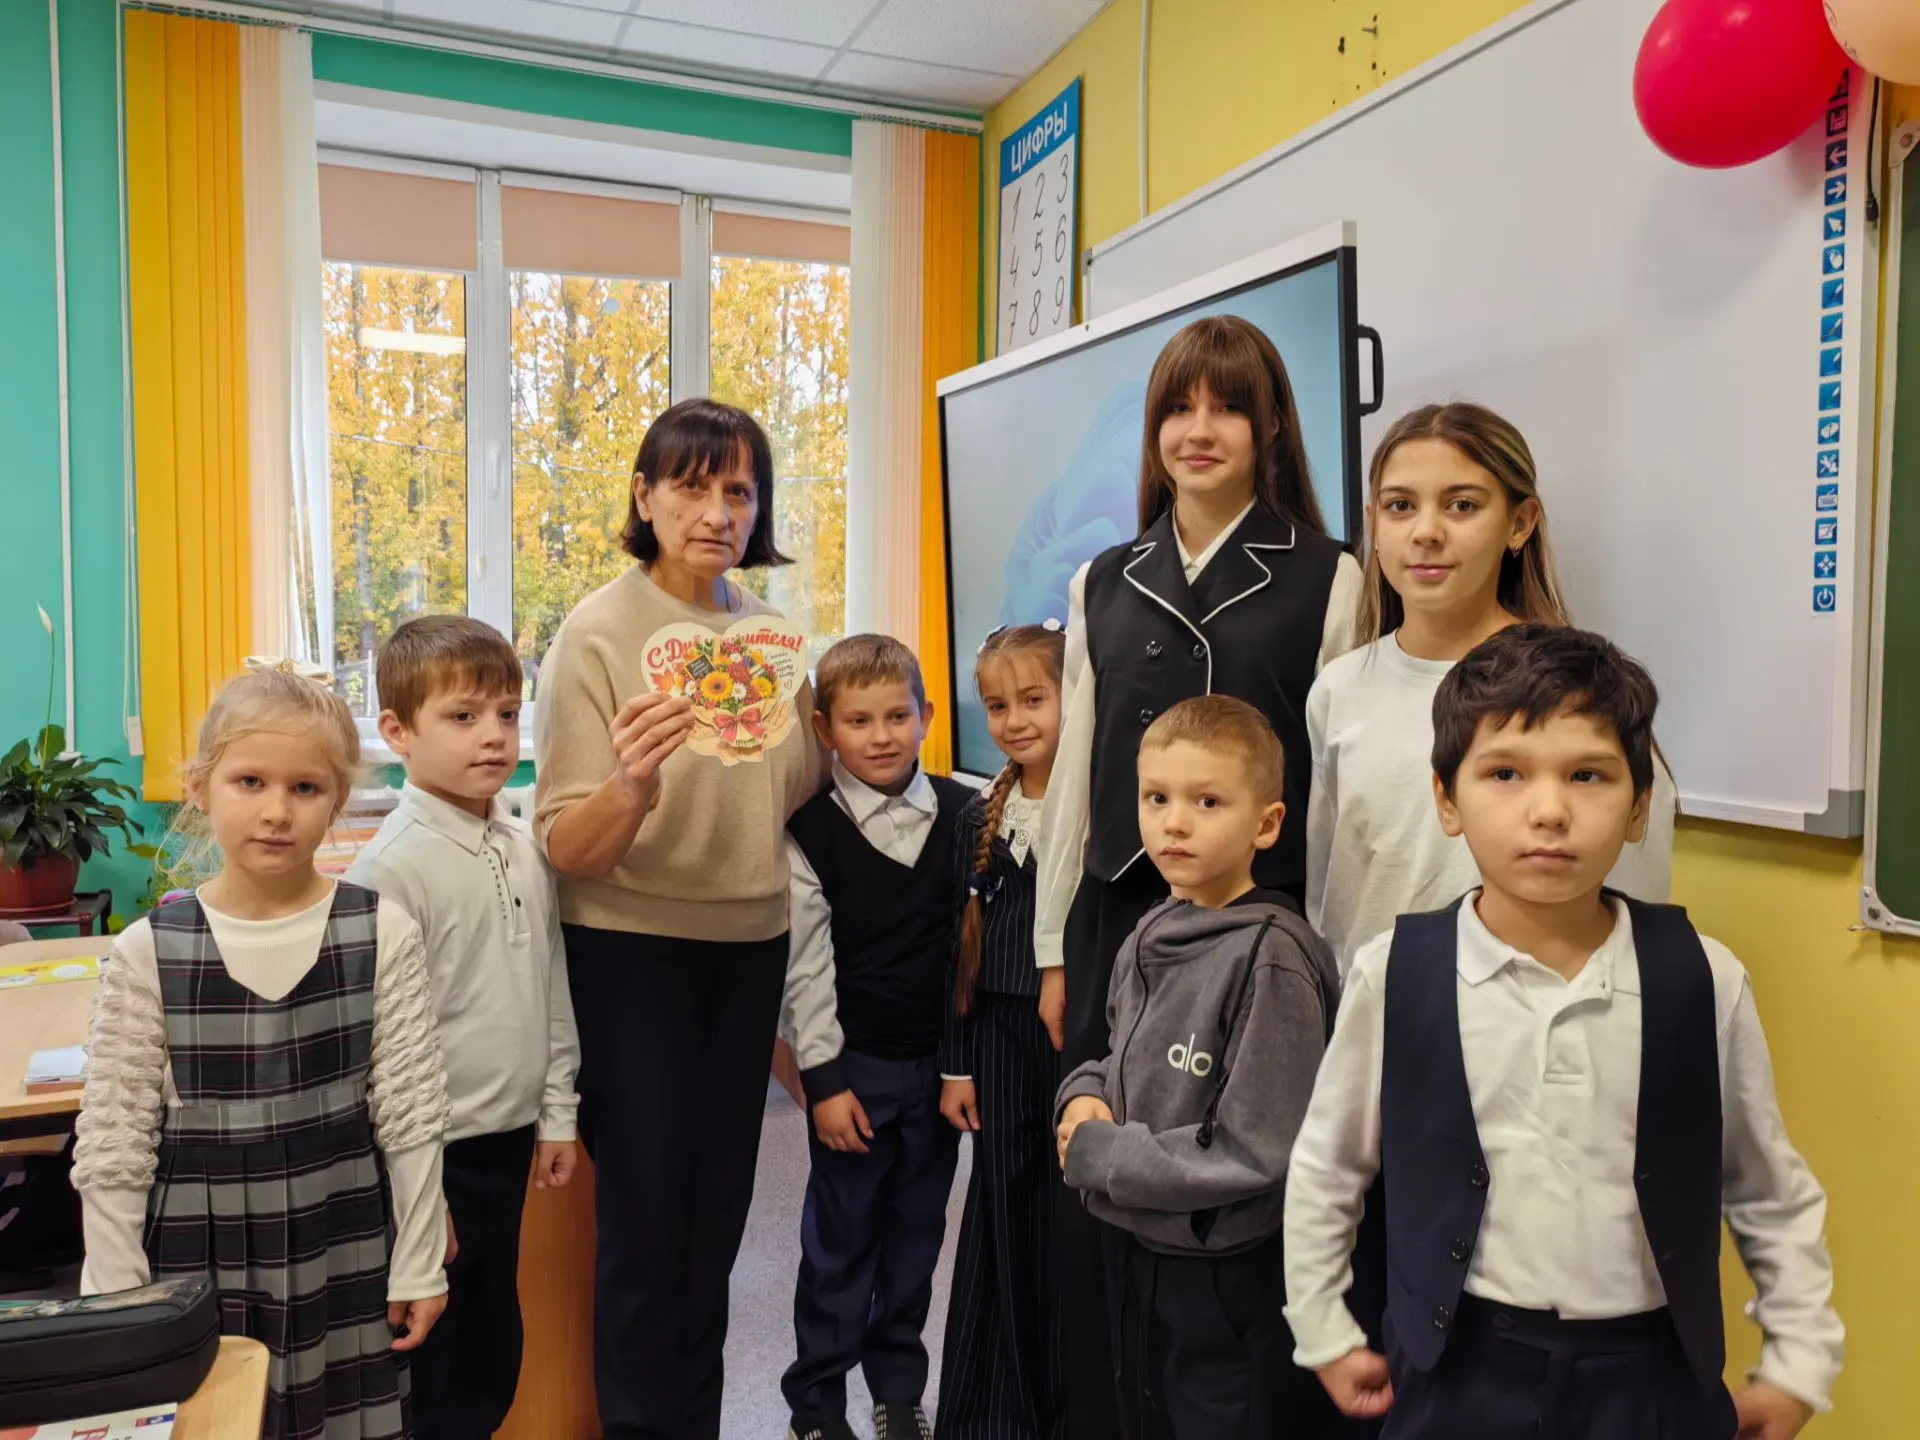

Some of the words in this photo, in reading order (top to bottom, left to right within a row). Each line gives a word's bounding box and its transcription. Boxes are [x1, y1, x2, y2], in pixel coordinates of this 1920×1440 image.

[1011, 102, 1068, 173] ЦИФРЫ
[1011, 186, 1022, 234] 1
[1033, 171, 1046, 221] 2
[1056, 153, 1069, 204] 3
[1009, 246, 1020, 288] 4
[1031, 230, 1044, 277] 5
[1054, 213, 1067, 263] 6
[1008, 300, 1018, 346] 7
[1028, 289, 1042, 336] 8
[1052, 275, 1065, 325] 9
[646, 646, 665, 669] С
[1167, 1032, 1213, 1077] alo
